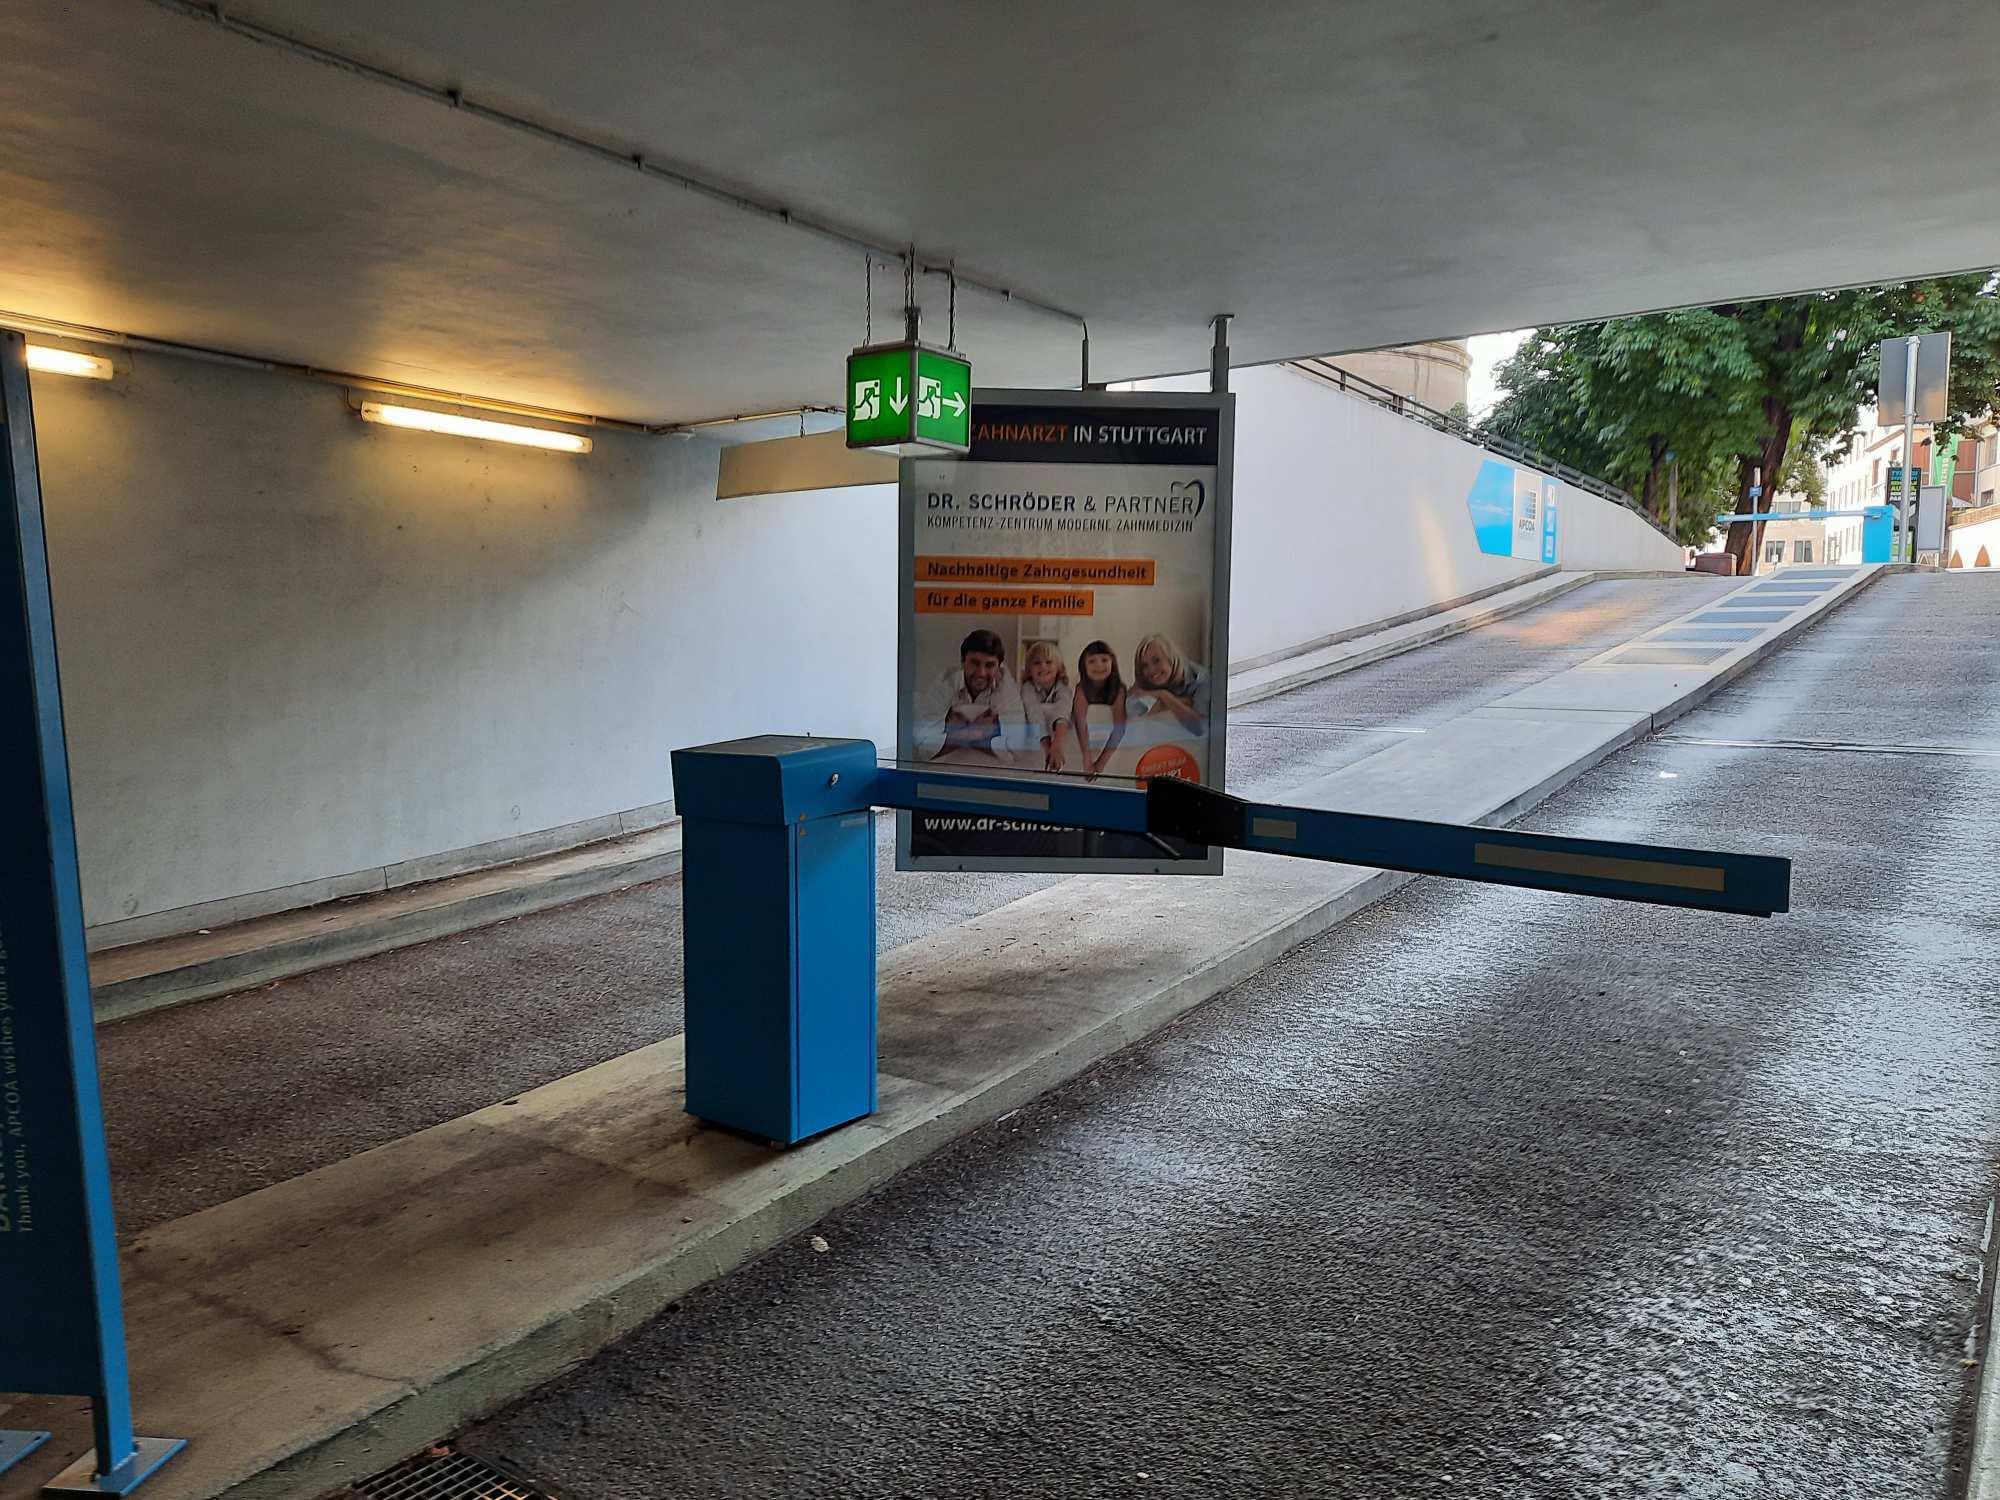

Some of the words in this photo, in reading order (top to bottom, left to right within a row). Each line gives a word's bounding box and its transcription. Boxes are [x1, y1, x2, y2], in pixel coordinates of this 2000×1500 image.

[1073, 425, 1092, 443] IN
[1098, 426, 1207, 444] STUTTGART
[927, 492, 960, 510] DR.
[968, 491, 1076, 512] SCHRÖDER
[1084, 495, 1096, 512] &
[1105, 496, 1194, 514] PARTNER
[1057, 517, 1109, 533] MODERNE
[1116, 518, 1193, 534] ZAHNMEDIZIN
[927, 562, 1018, 580] Nachhaltige
[1023, 563, 1147, 580] Zahngesundheit
[927, 592, 949, 608] für
[953, 592, 977, 608] die
[981, 596, 1027, 611] ganze
[1031, 595, 1085, 610] Familie
[0, 1017, 16, 1074] wishes
[7, 1080, 24, 1137] APCOA
[13, 1184, 33, 1233] Thank
